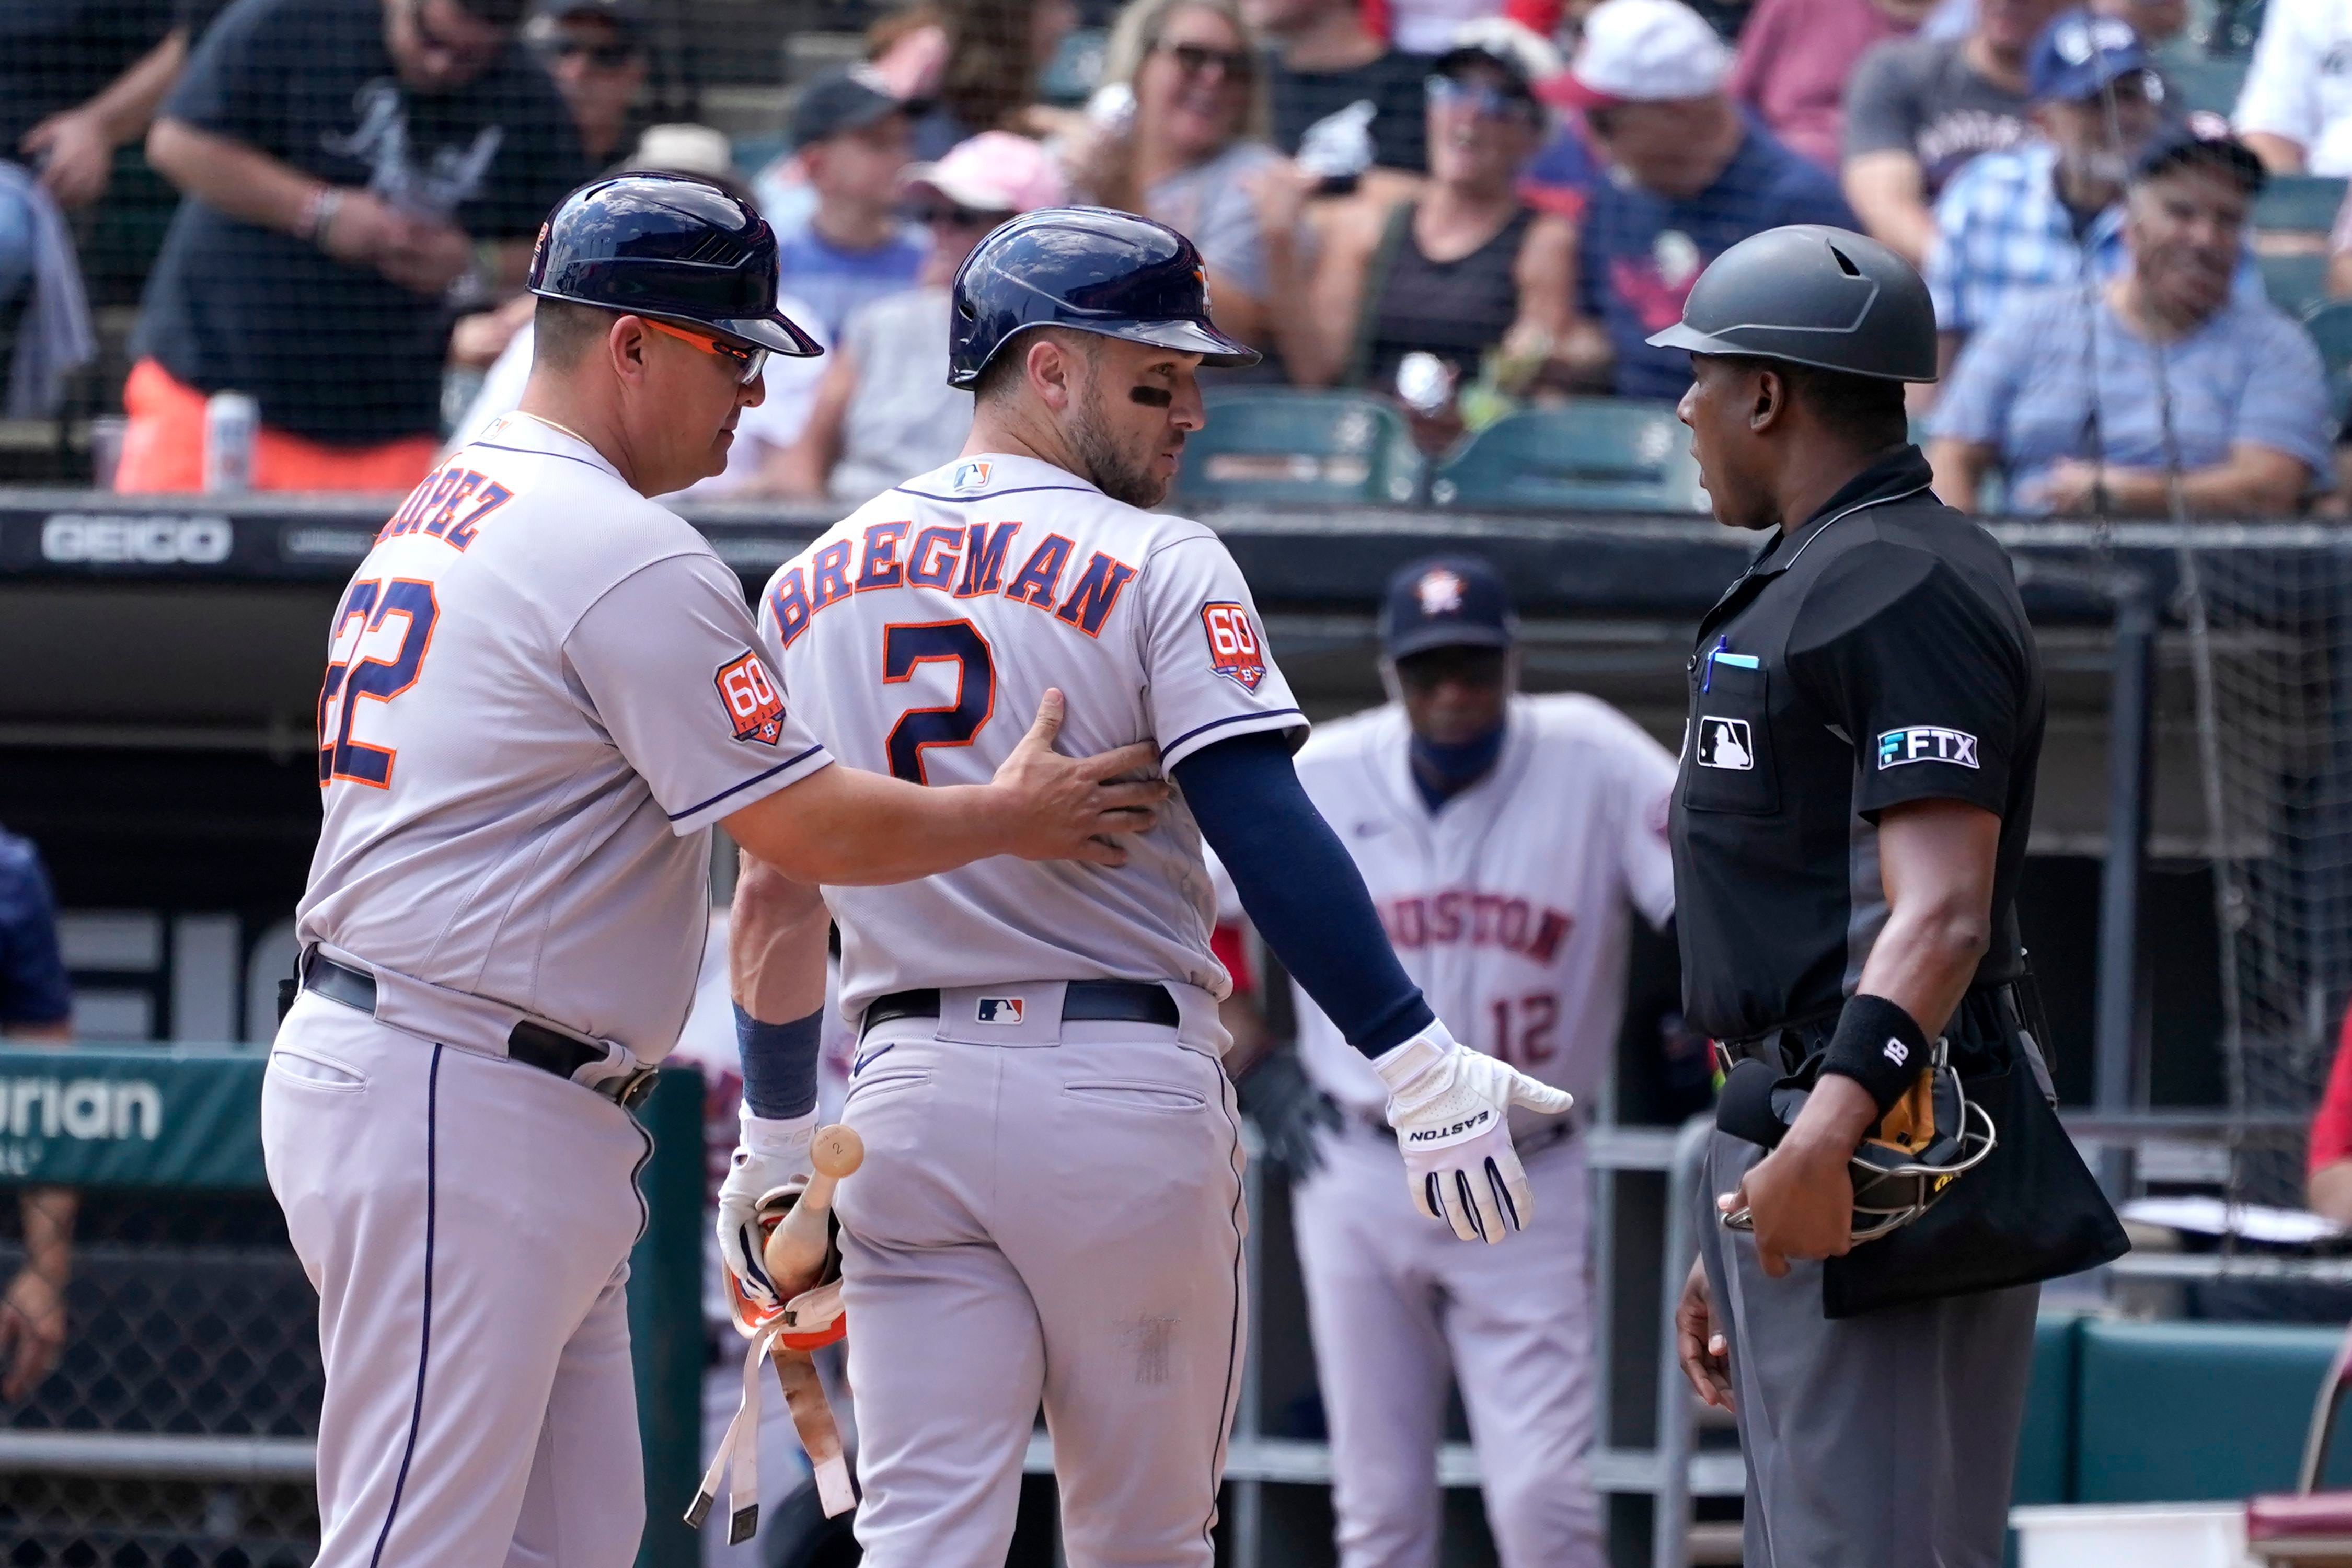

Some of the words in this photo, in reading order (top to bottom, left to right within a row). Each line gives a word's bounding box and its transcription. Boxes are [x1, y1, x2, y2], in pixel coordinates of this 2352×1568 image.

[41, 514, 234, 563] GEICO
[768, 521, 1138, 649] BREGMAN
[1208, 609, 1256, 655] 60
[317, 578, 440, 790] 22
[723, 657, 774, 718] 60
[883, 618, 996, 786] 2
[1491, 994, 1560, 1068] 12
[1883, 1037, 1909, 1067] 18
[832, 1142, 844, 1155] 2
[1409, 1110, 1489, 1142] EASTON
